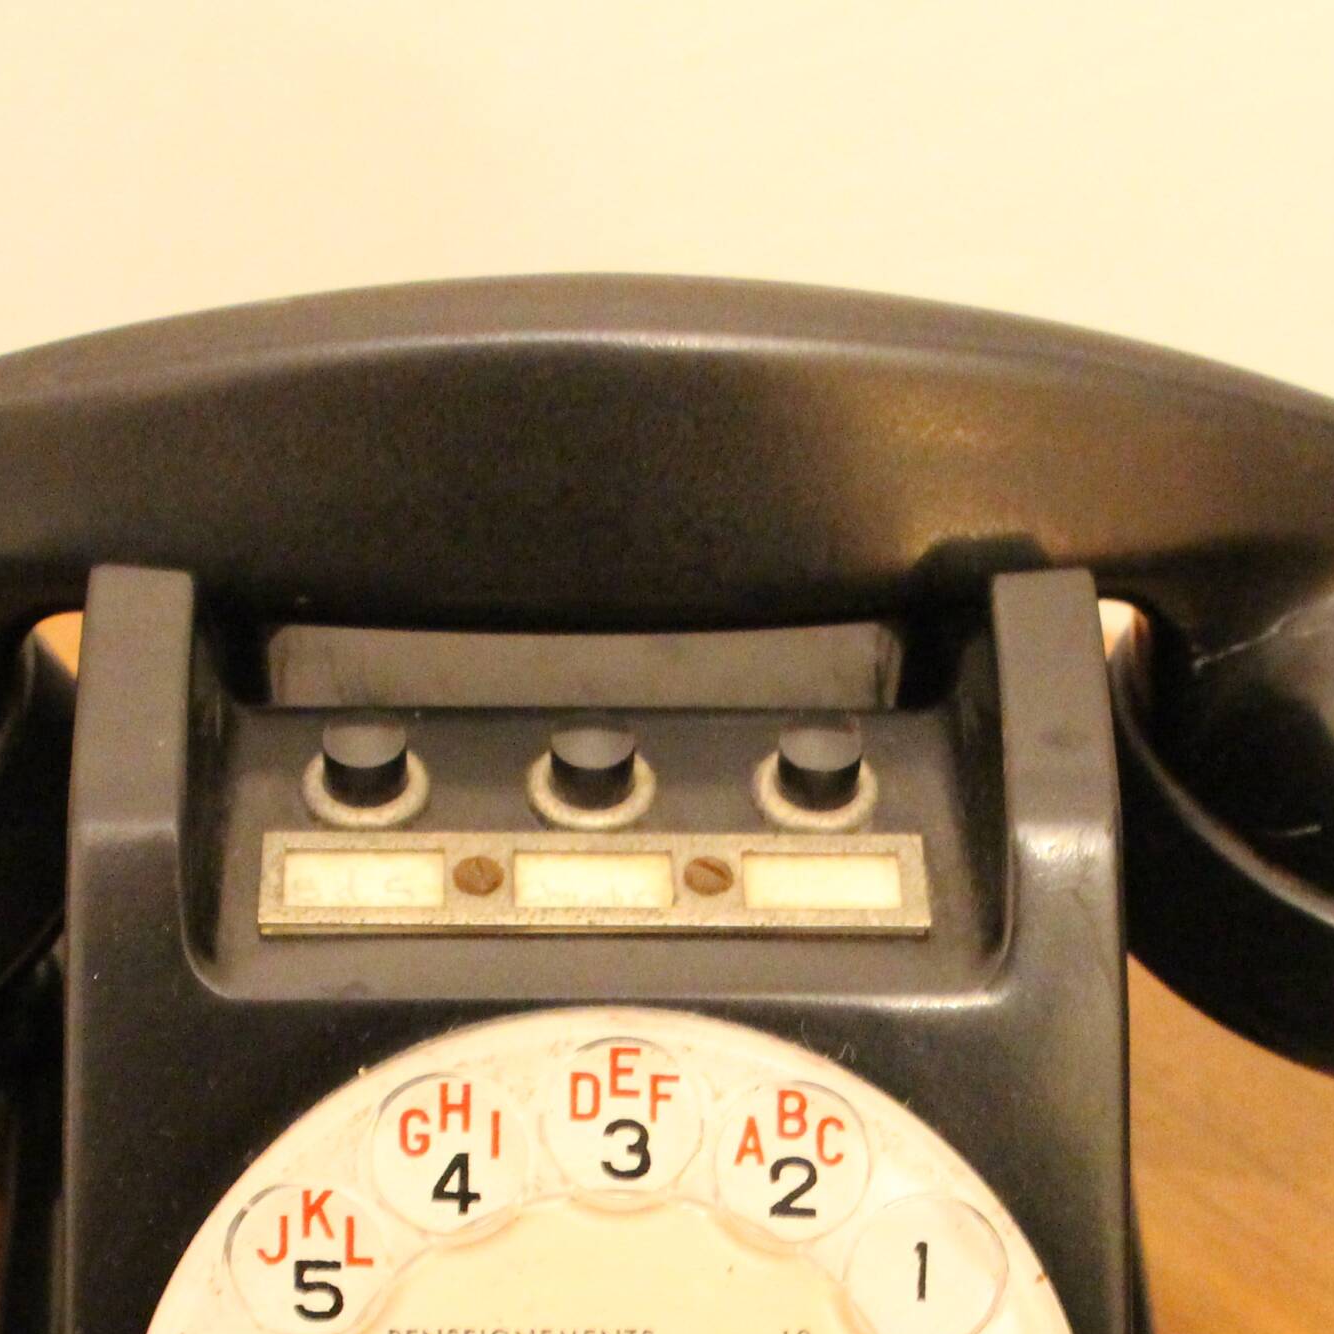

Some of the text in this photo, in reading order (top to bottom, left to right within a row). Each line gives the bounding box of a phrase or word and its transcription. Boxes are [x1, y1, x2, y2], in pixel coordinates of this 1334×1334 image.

[601, 1118, 652, 1180] 3
[432, 1152, 481, 1215] 4
[769, 1156, 818, 1218] 2
[293, 1259, 345, 1322] 5
[913, 1241, 929, 1302] 1
